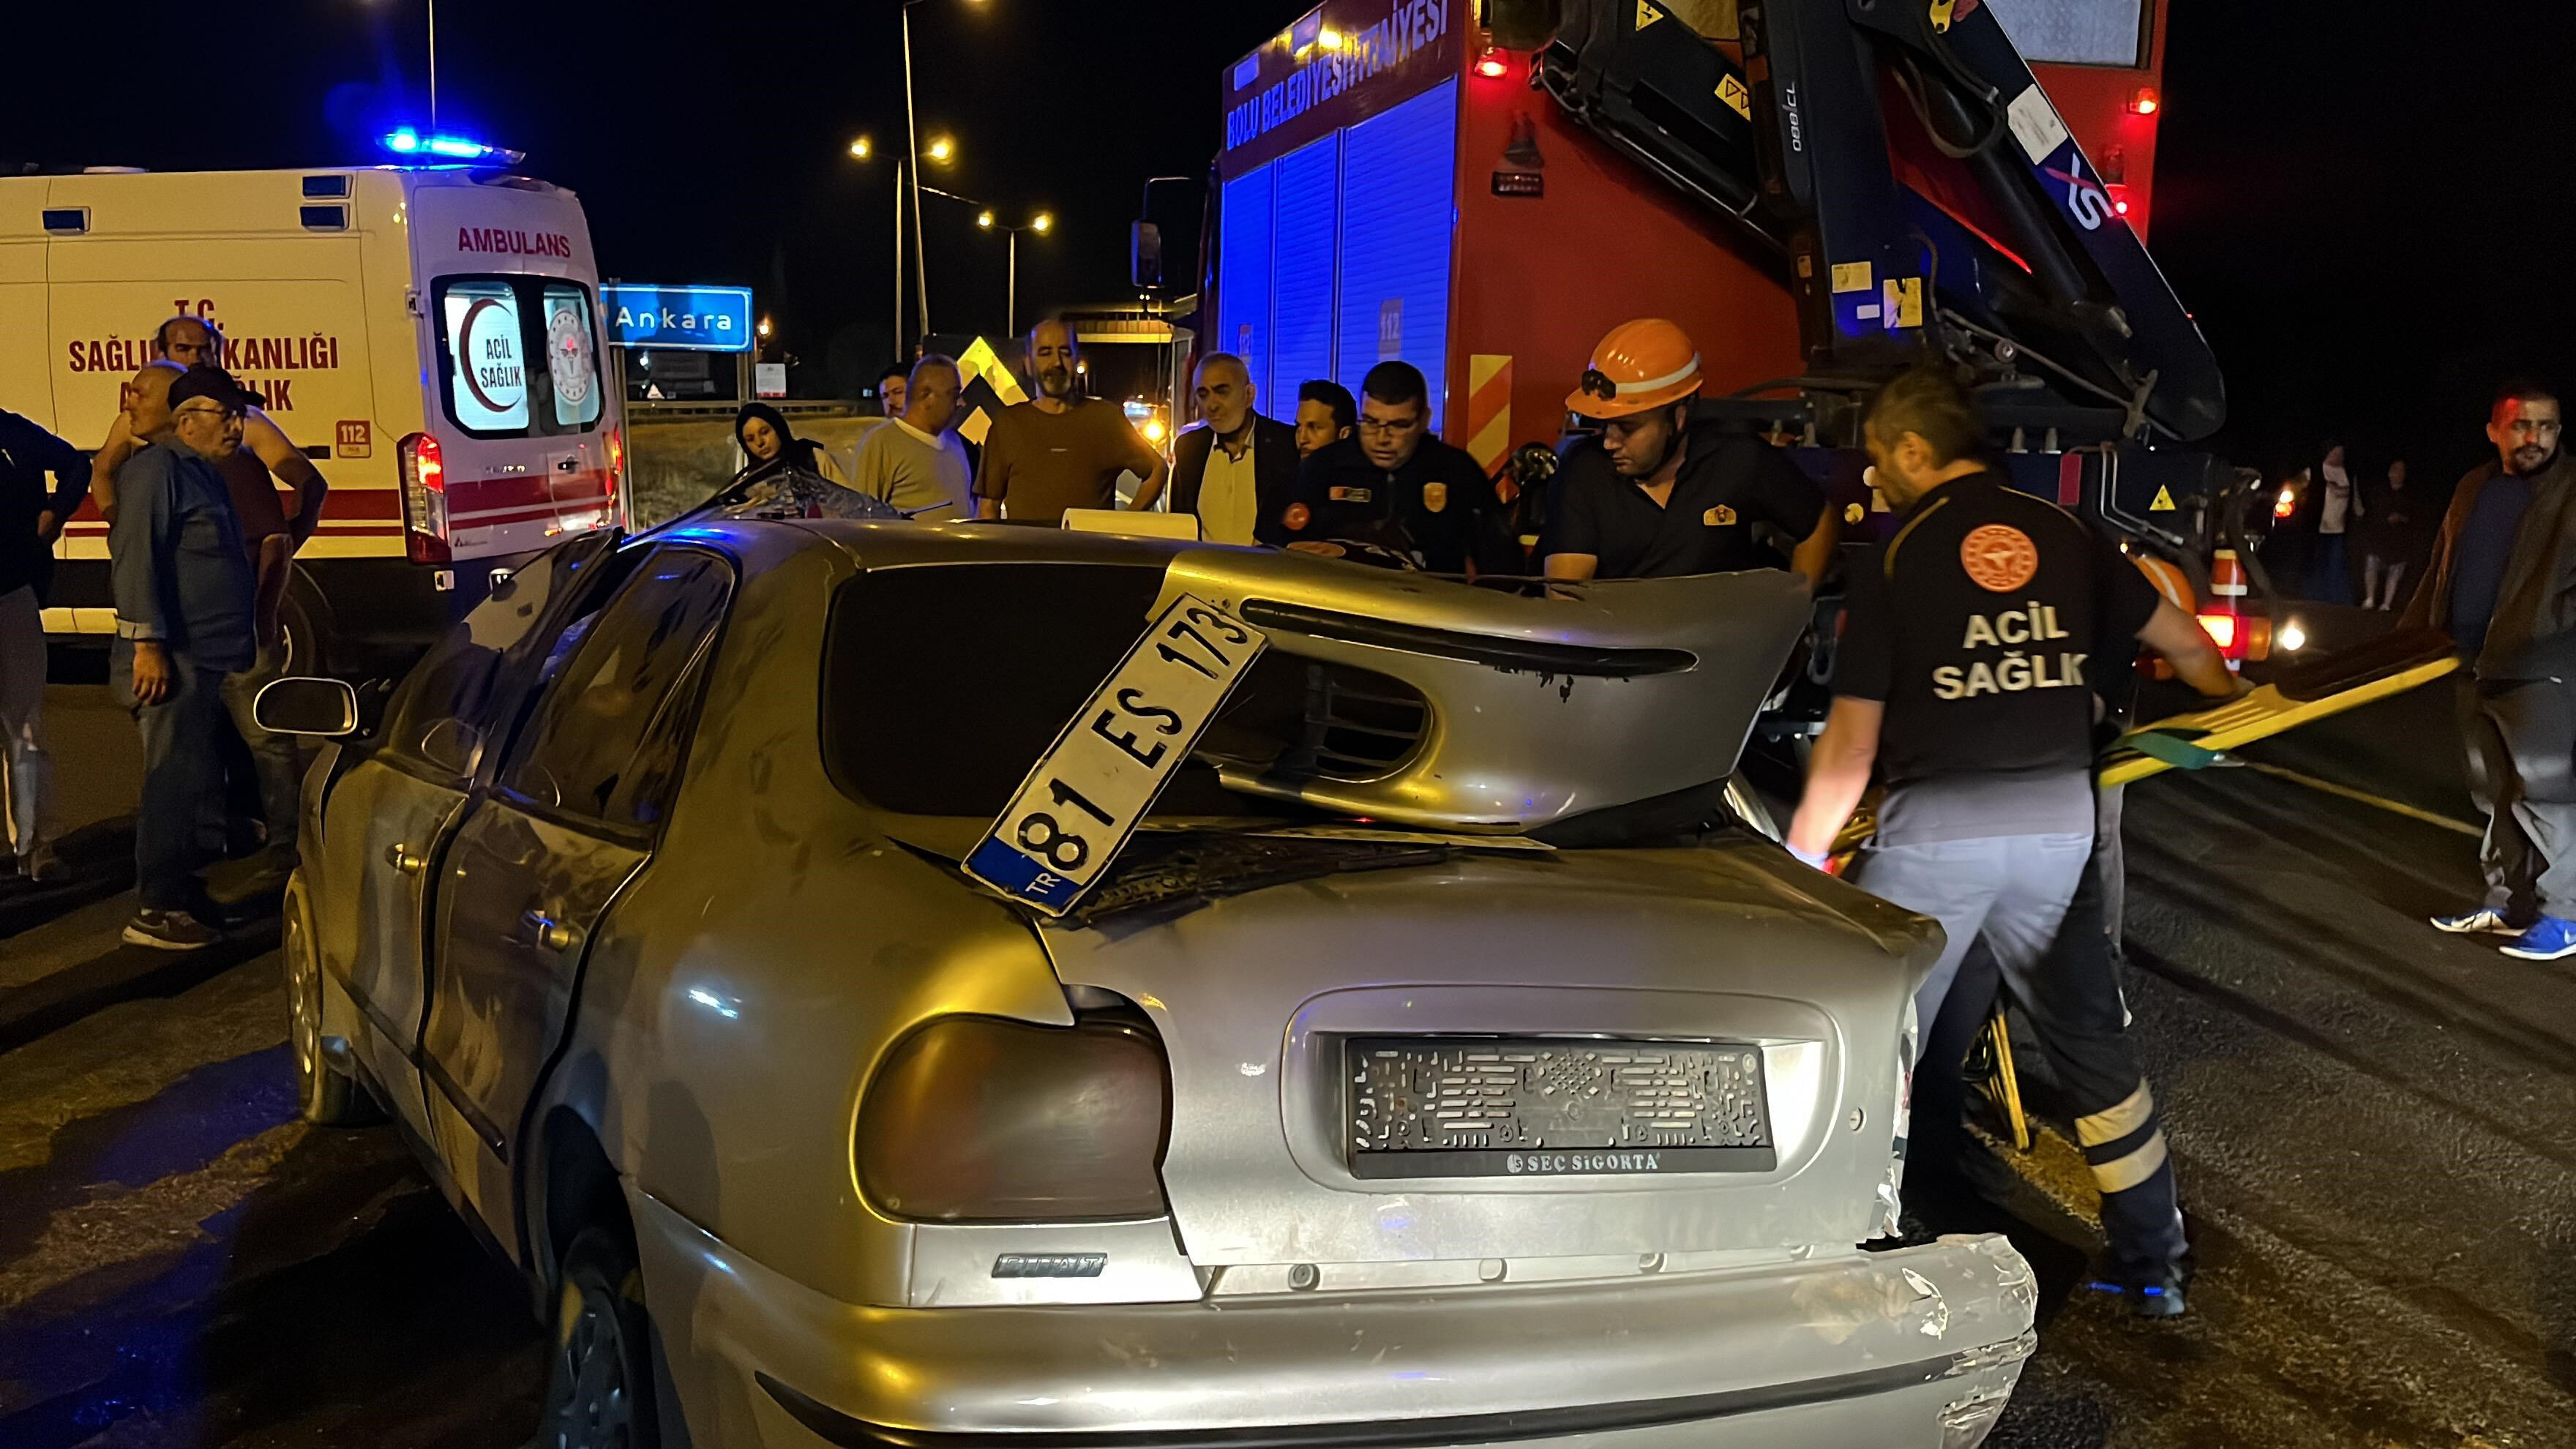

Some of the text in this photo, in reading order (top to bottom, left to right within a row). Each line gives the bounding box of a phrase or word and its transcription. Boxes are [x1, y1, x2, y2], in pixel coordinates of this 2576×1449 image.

[1227, 96, 1260, 152] BOLU
[2044, 151, 2114, 231] XS
[458, 227, 571, 258] AMBULANS
[615, 306, 733, 330] Ankara
[223, 332, 338, 370] KANLIĞI
[486, 334, 512, 360] ACİL
[480, 362, 522, 388] SAĞLIK
[341, 424, 366, 443] 112
[1962, 600, 2070, 649] ACİL
[1018, 607, 1248, 872] 81 ES 173
[1025, 872, 1062, 894] TR
